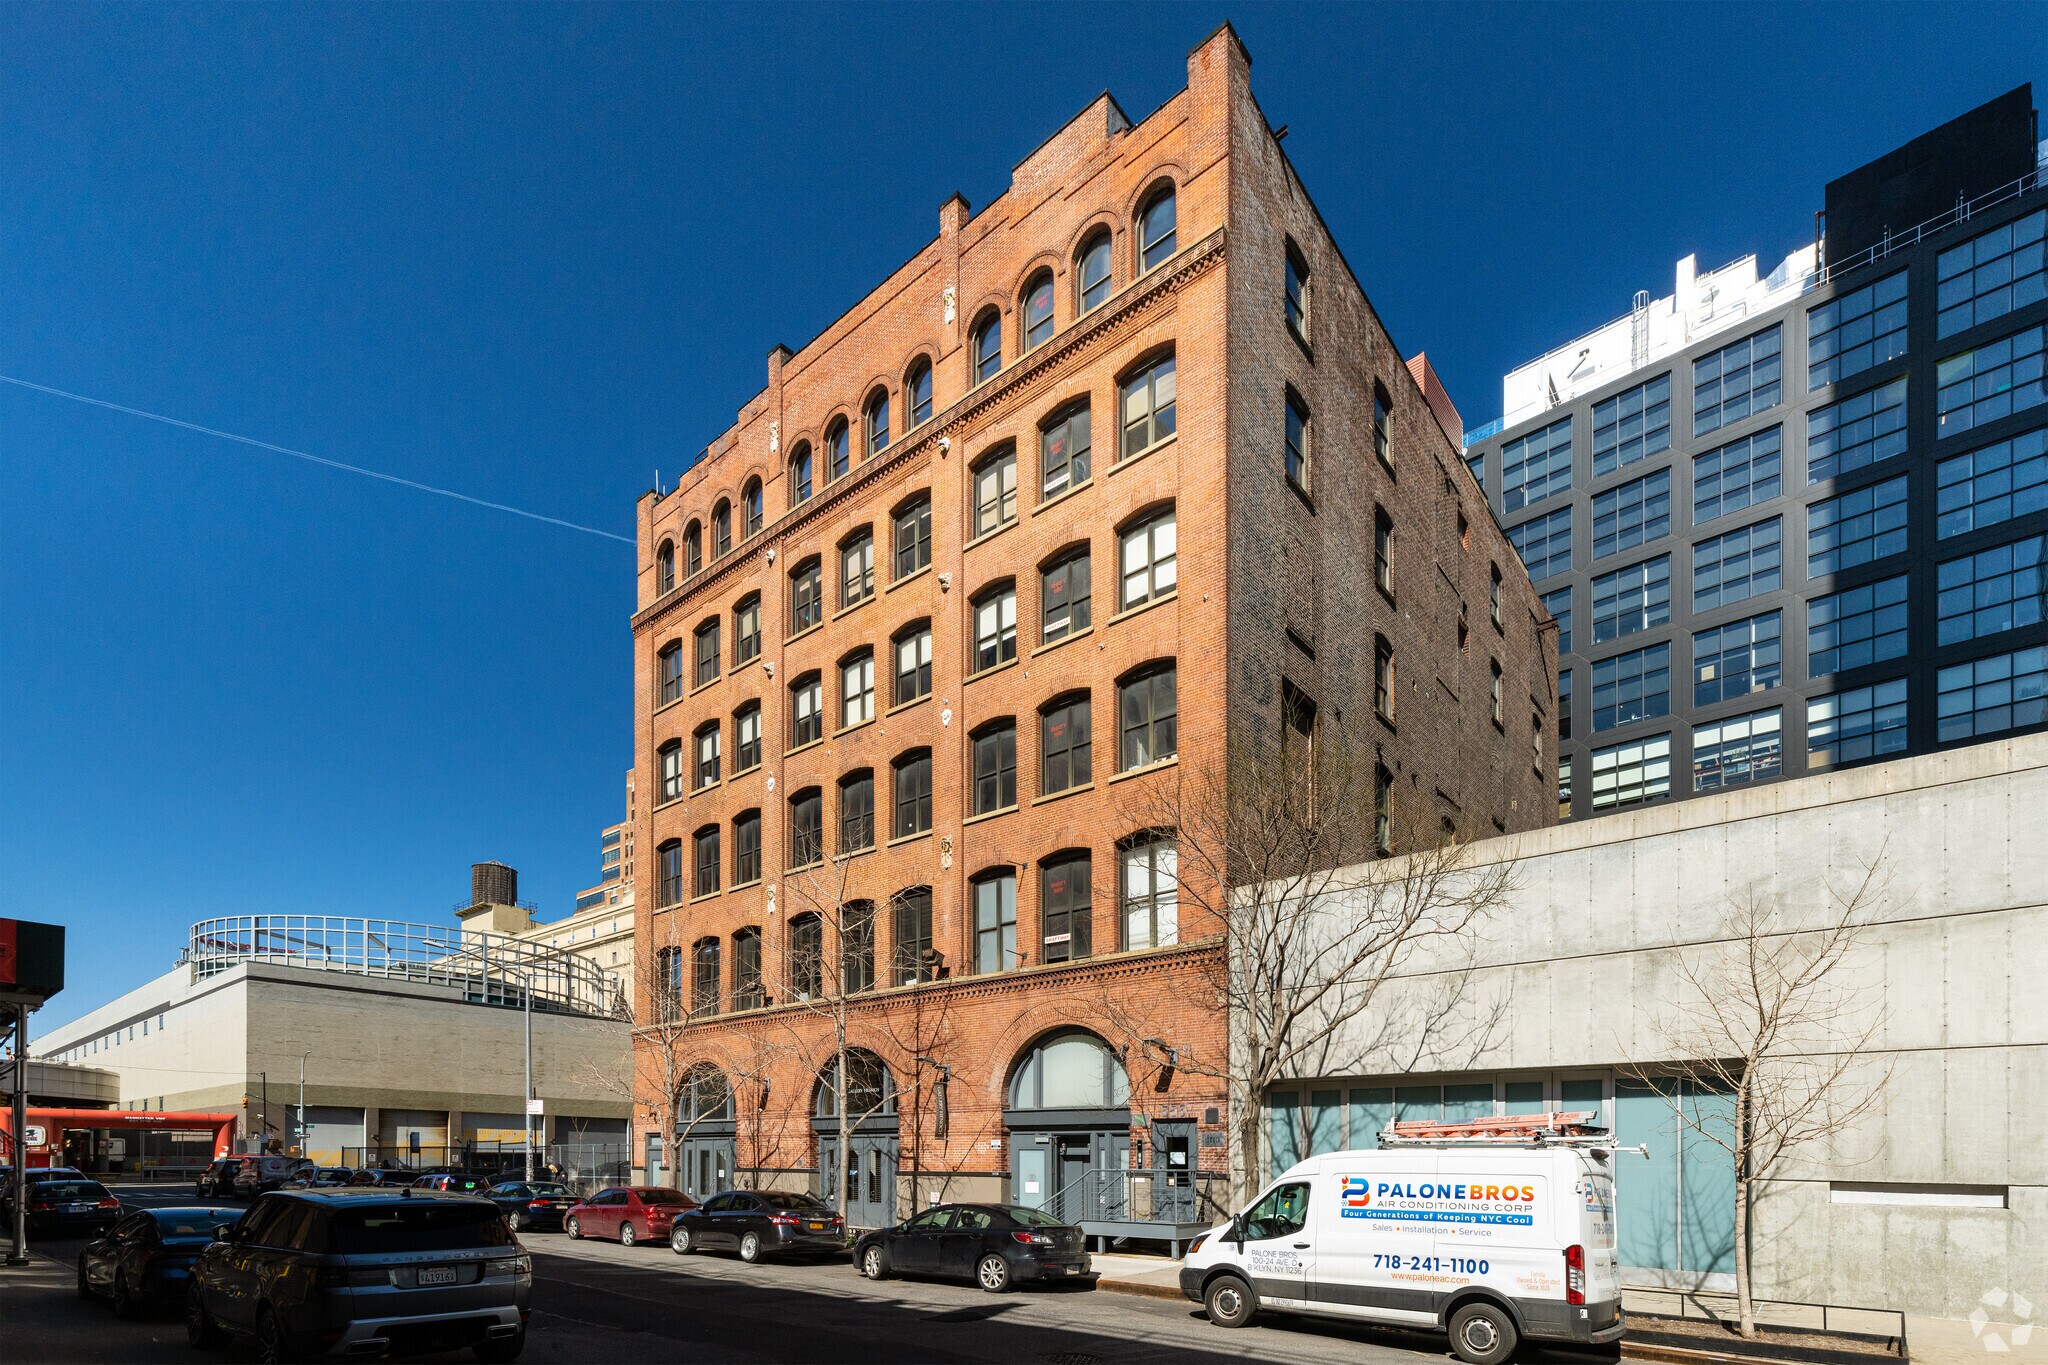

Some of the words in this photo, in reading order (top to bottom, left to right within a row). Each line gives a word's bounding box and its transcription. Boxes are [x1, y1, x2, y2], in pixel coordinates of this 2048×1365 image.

[1045, 934, 1070, 943] SHAFTWAY
[1377, 1183, 1467, 1200] PALONE
[1469, 1184, 1535, 1202] BROS
[1376, 1200, 1396, 1208] AIR
[1399, 1201, 1490, 1211] CONDITIONING
[1494, 1203, 1533, 1213] CORP
[1344, 1209, 1364, 1217] Four
[1366, 1210, 1420, 1219] Generations
[1423, 1212, 1434, 1220] of
[1437, 1213, 1476, 1223] Keeping
[1480, 1214, 1502, 1223] NYC
[1506, 1215, 1530, 1224] Cool
[1372, 1223, 1393, 1232] Sales
[1402, 1225, 1449, 1234] Installation
[1458, 1227, 1492, 1237] Service
[382, 1254, 434, 1263] RANGE
[443, 1251, 490, 1260] ROVER
[1251, 1249, 1277, 1258] PALONE
[1252, 1256, 1274, 1265] 100-24
[1373, 1253, 1490, 1275] 718-241-1100
[1274, 1265, 1285, 1273] NY
[1390, 1272, 1470, 1285] www.paloneac.com
